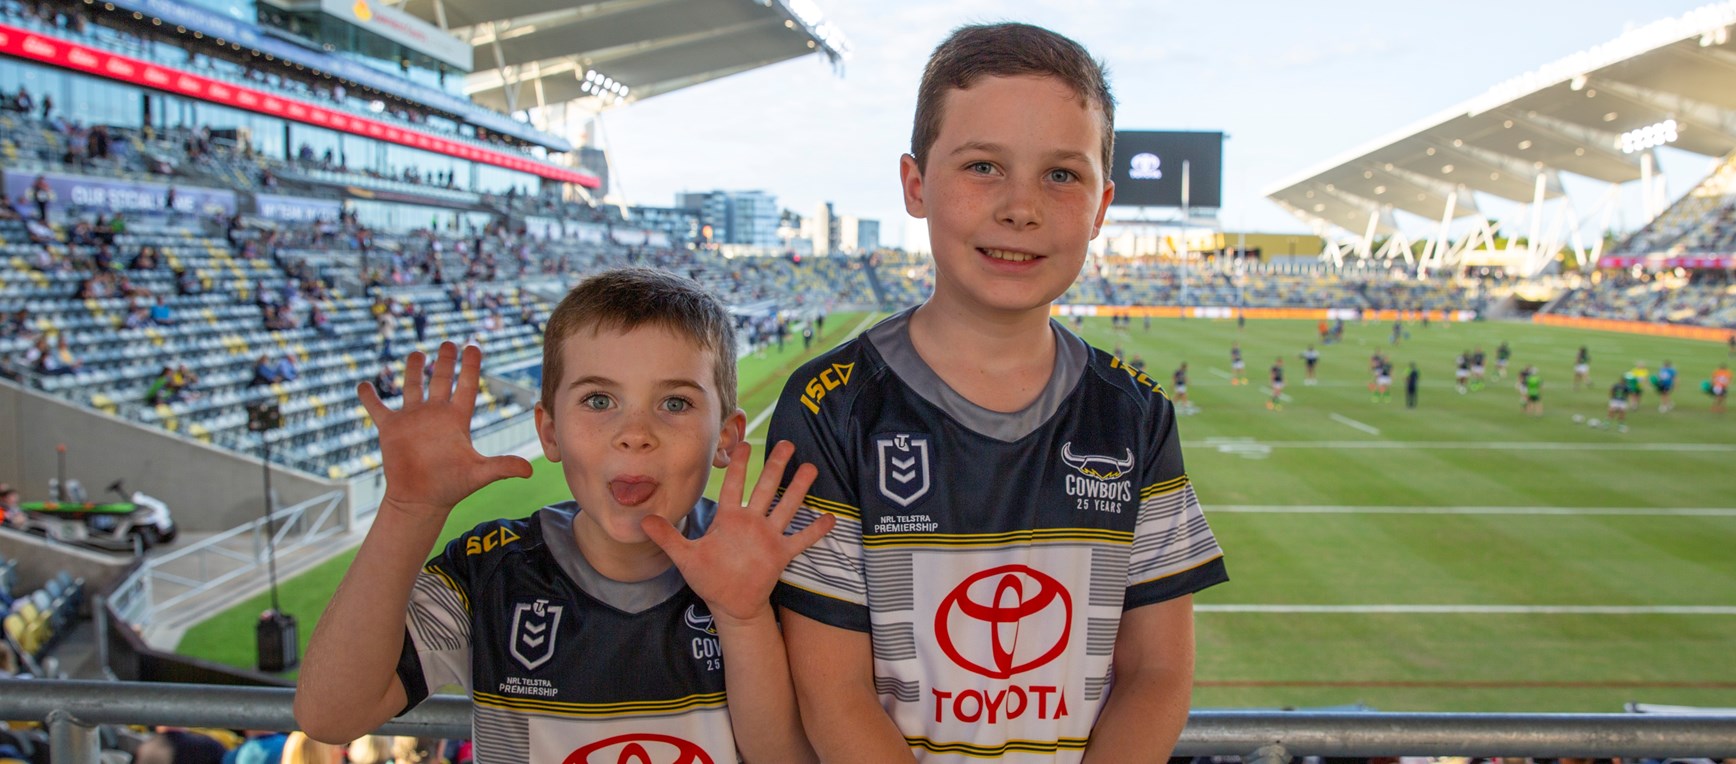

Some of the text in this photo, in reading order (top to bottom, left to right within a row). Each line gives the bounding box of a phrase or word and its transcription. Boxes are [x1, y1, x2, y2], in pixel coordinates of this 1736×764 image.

[1066, 474, 1131, 502] COWBOYS
[1077, 499, 1122, 514] 25 YEARS
[881, 515, 931, 524] NRL TELSTRA
[874, 522, 938, 533] PREMIERSHIP
[707, 659, 720, 671] 25
[507, 677, 552, 687] NRL TELSTRA
[499, 683, 558, 697] PREMIERSHIP
[932, 685, 1068, 724] TOYOTA
